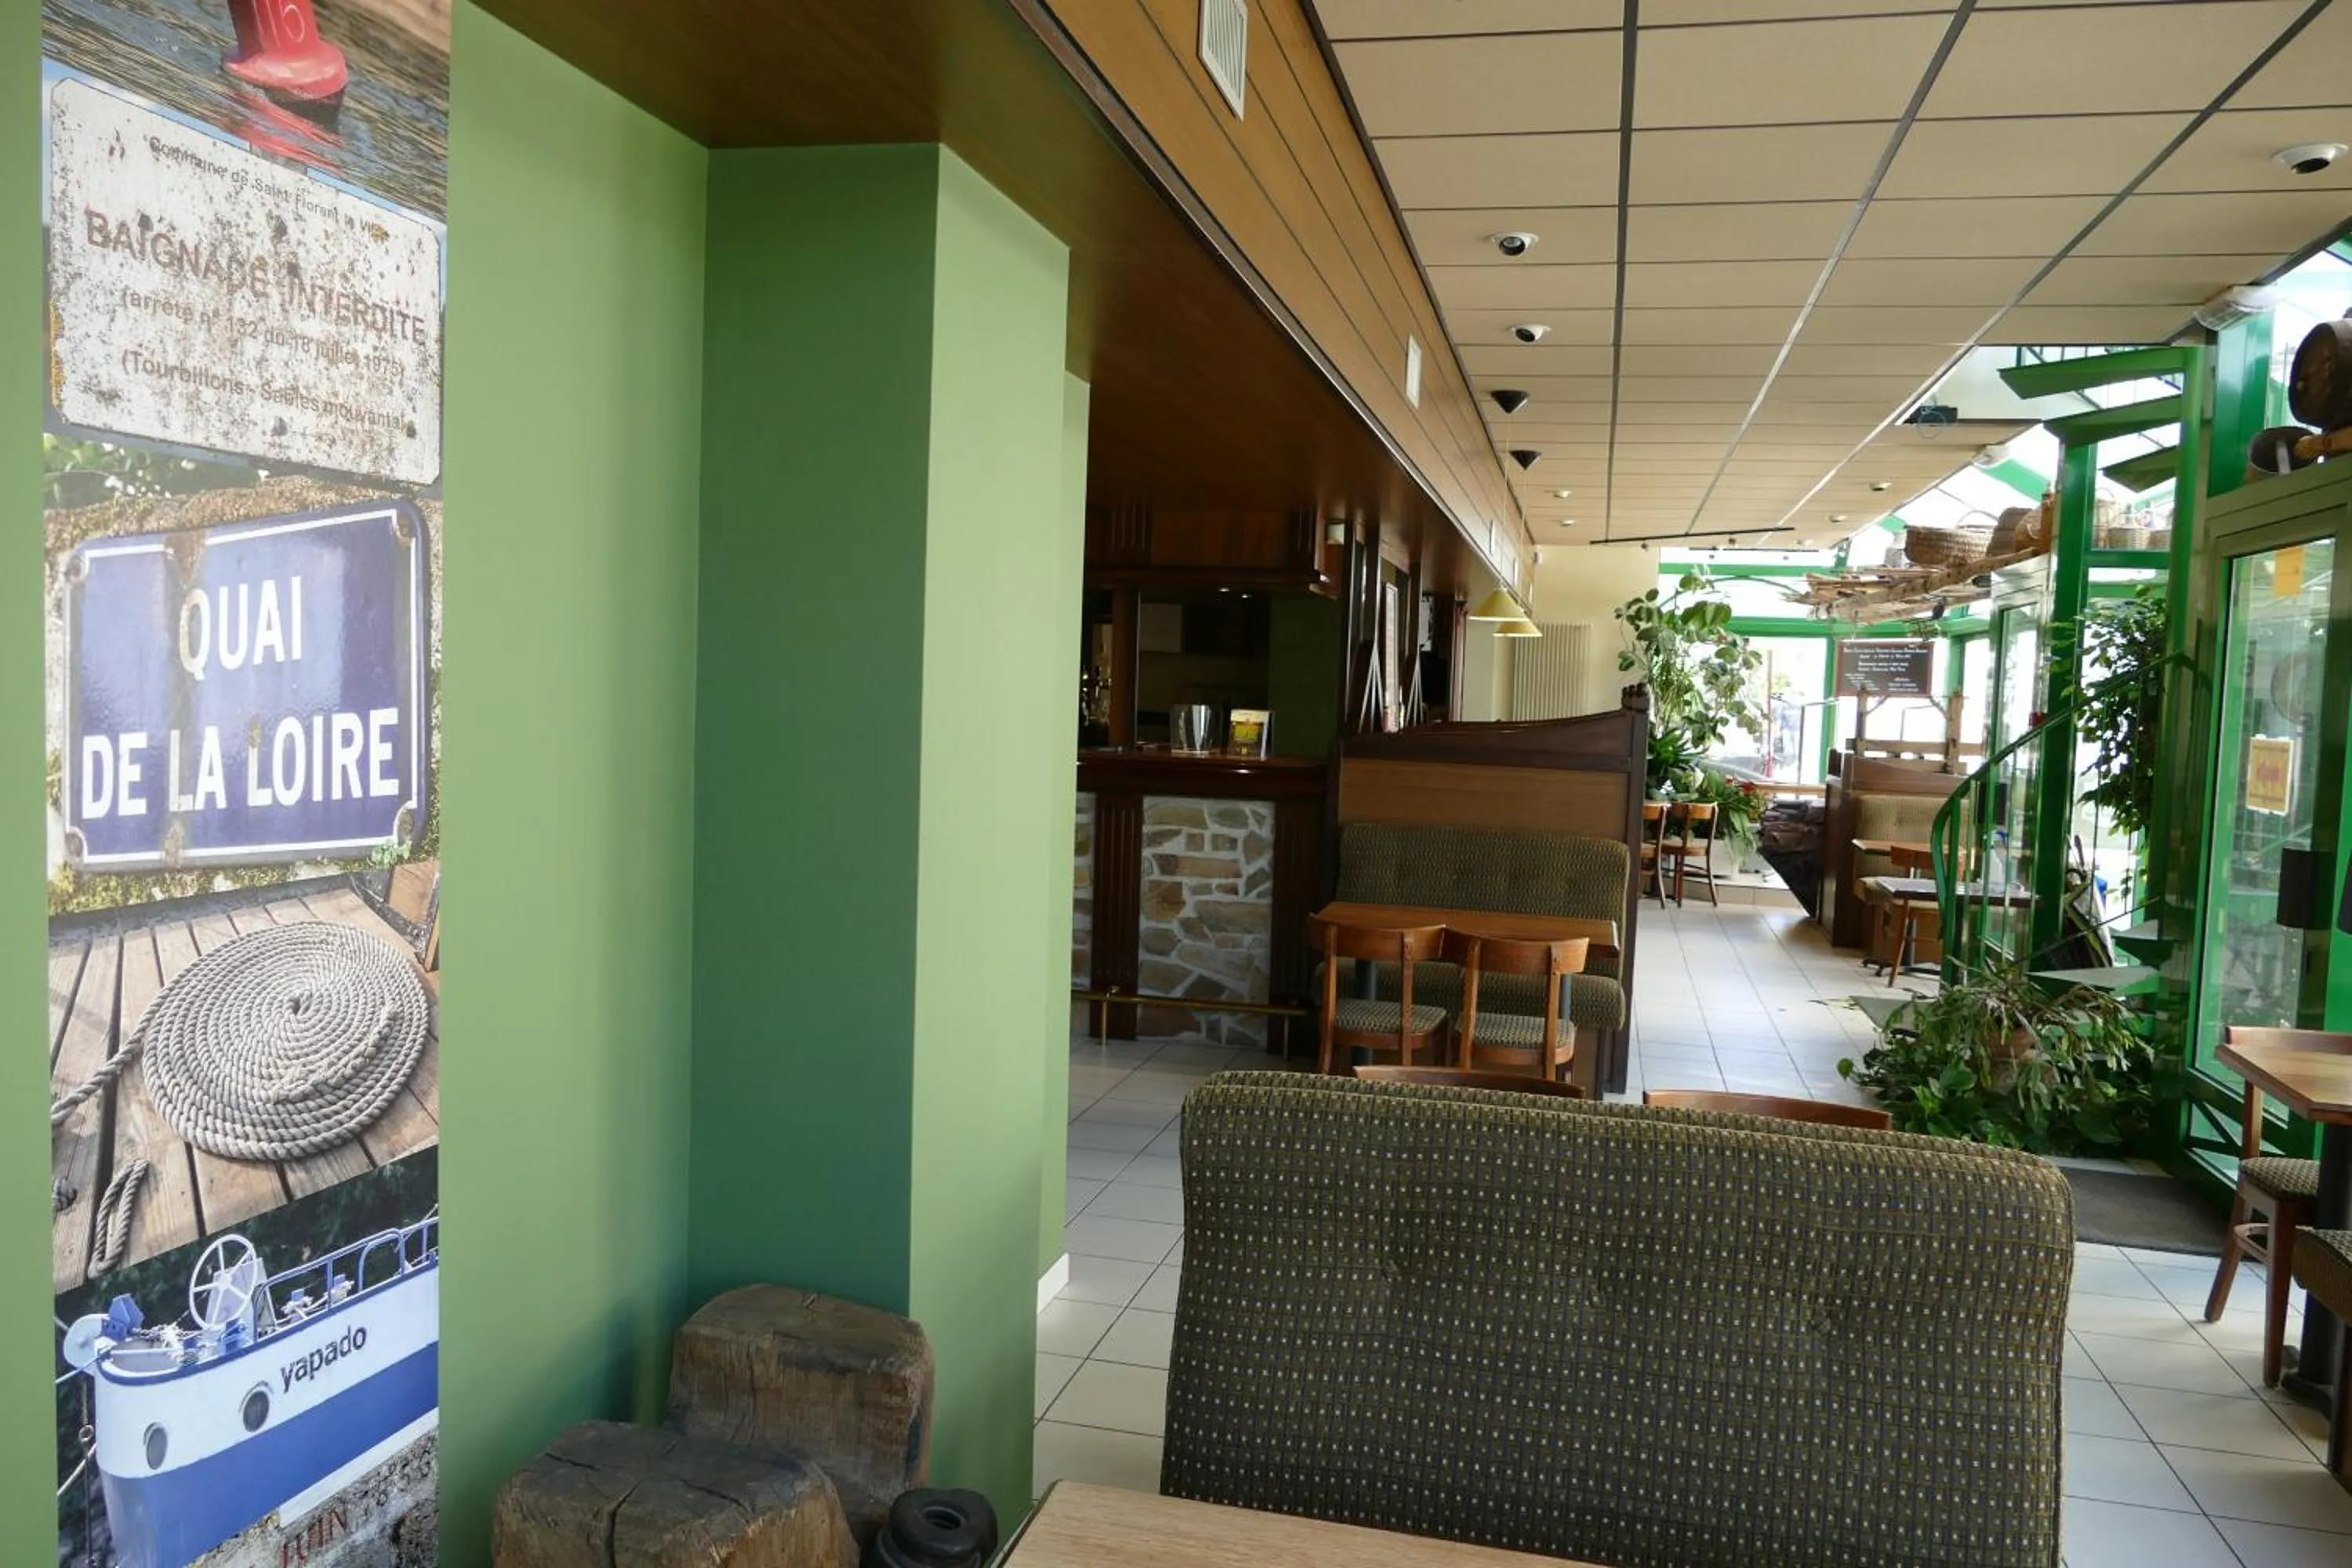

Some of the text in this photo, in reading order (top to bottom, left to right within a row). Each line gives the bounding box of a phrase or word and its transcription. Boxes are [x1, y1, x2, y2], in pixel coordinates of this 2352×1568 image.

[84, 207, 426, 346] BAIGNADE INTERDITE
[179, 575, 303, 681] QUAI
[81, 707, 400, 819] DE LA LOIRE
[281, 1325, 366, 1393] yapado
